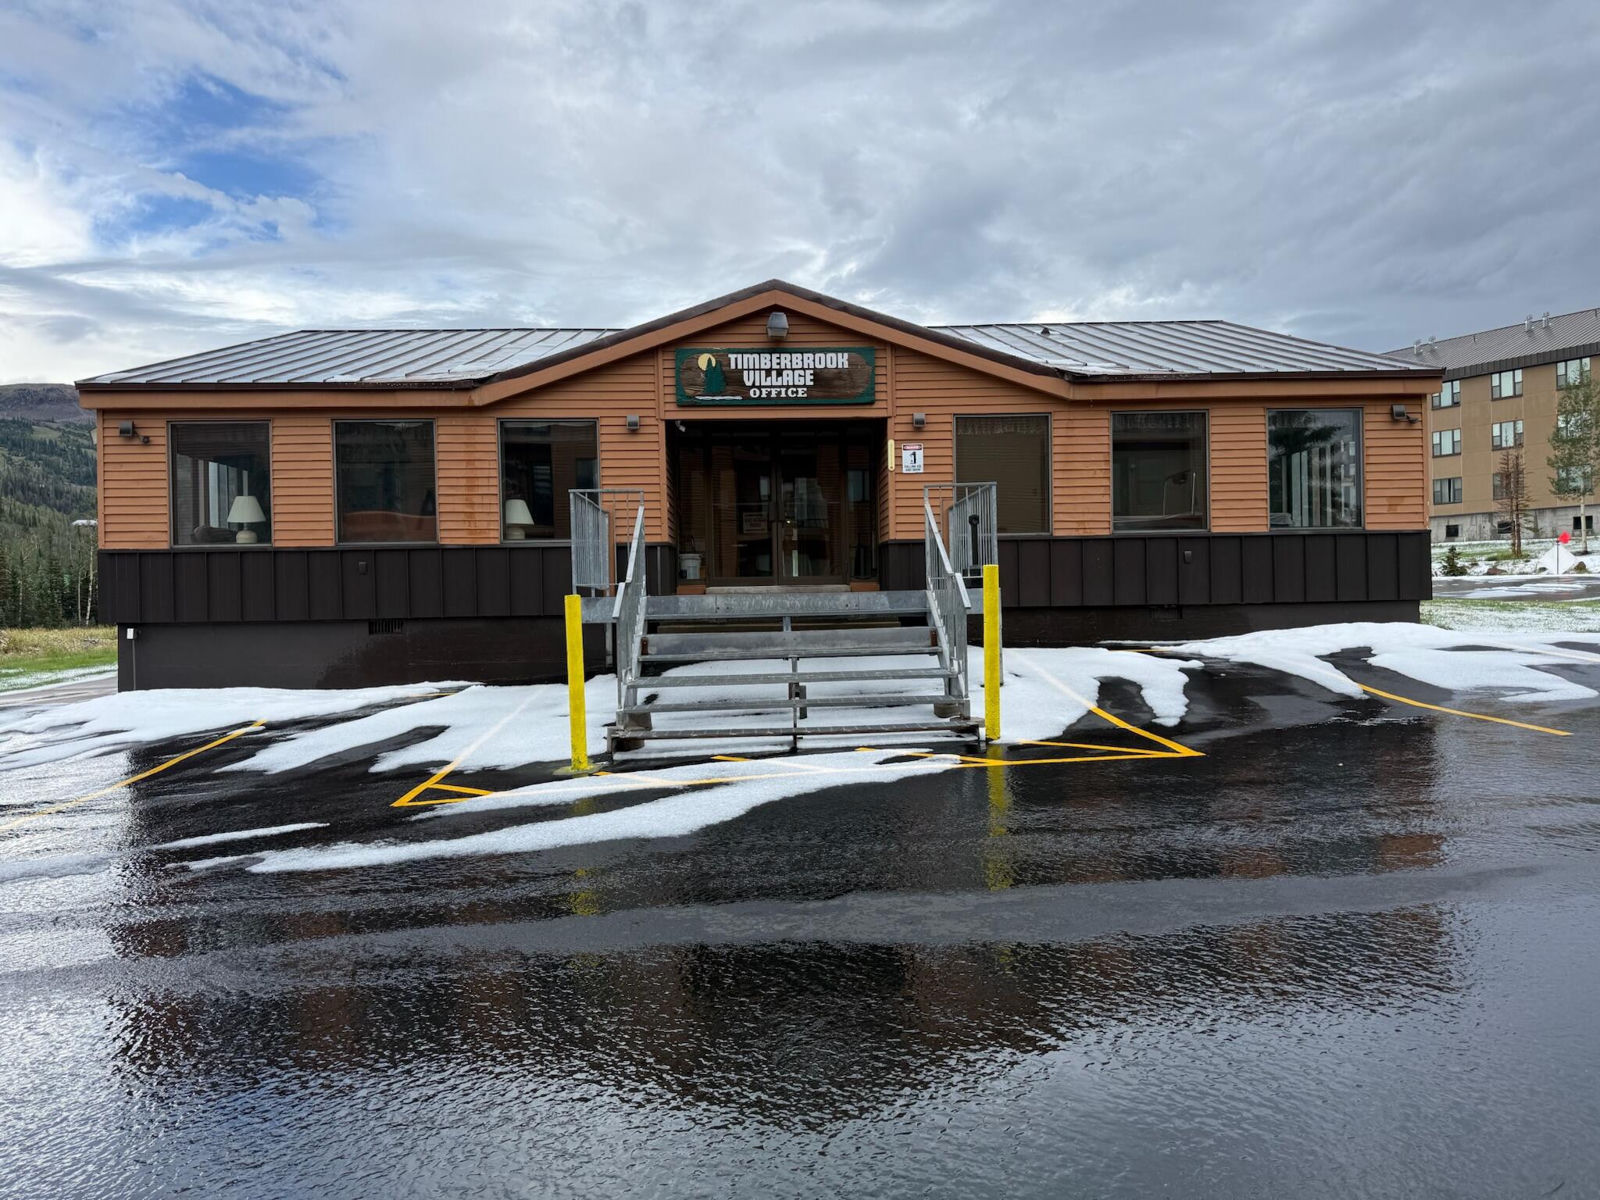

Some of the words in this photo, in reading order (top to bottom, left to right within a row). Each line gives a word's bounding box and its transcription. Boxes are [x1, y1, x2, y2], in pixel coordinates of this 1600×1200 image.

[728, 353, 848, 369] TIMBERBROOK
[743, 370, 814, 386] VILLAGE
[750, 387, 807, 398] OFFICE
